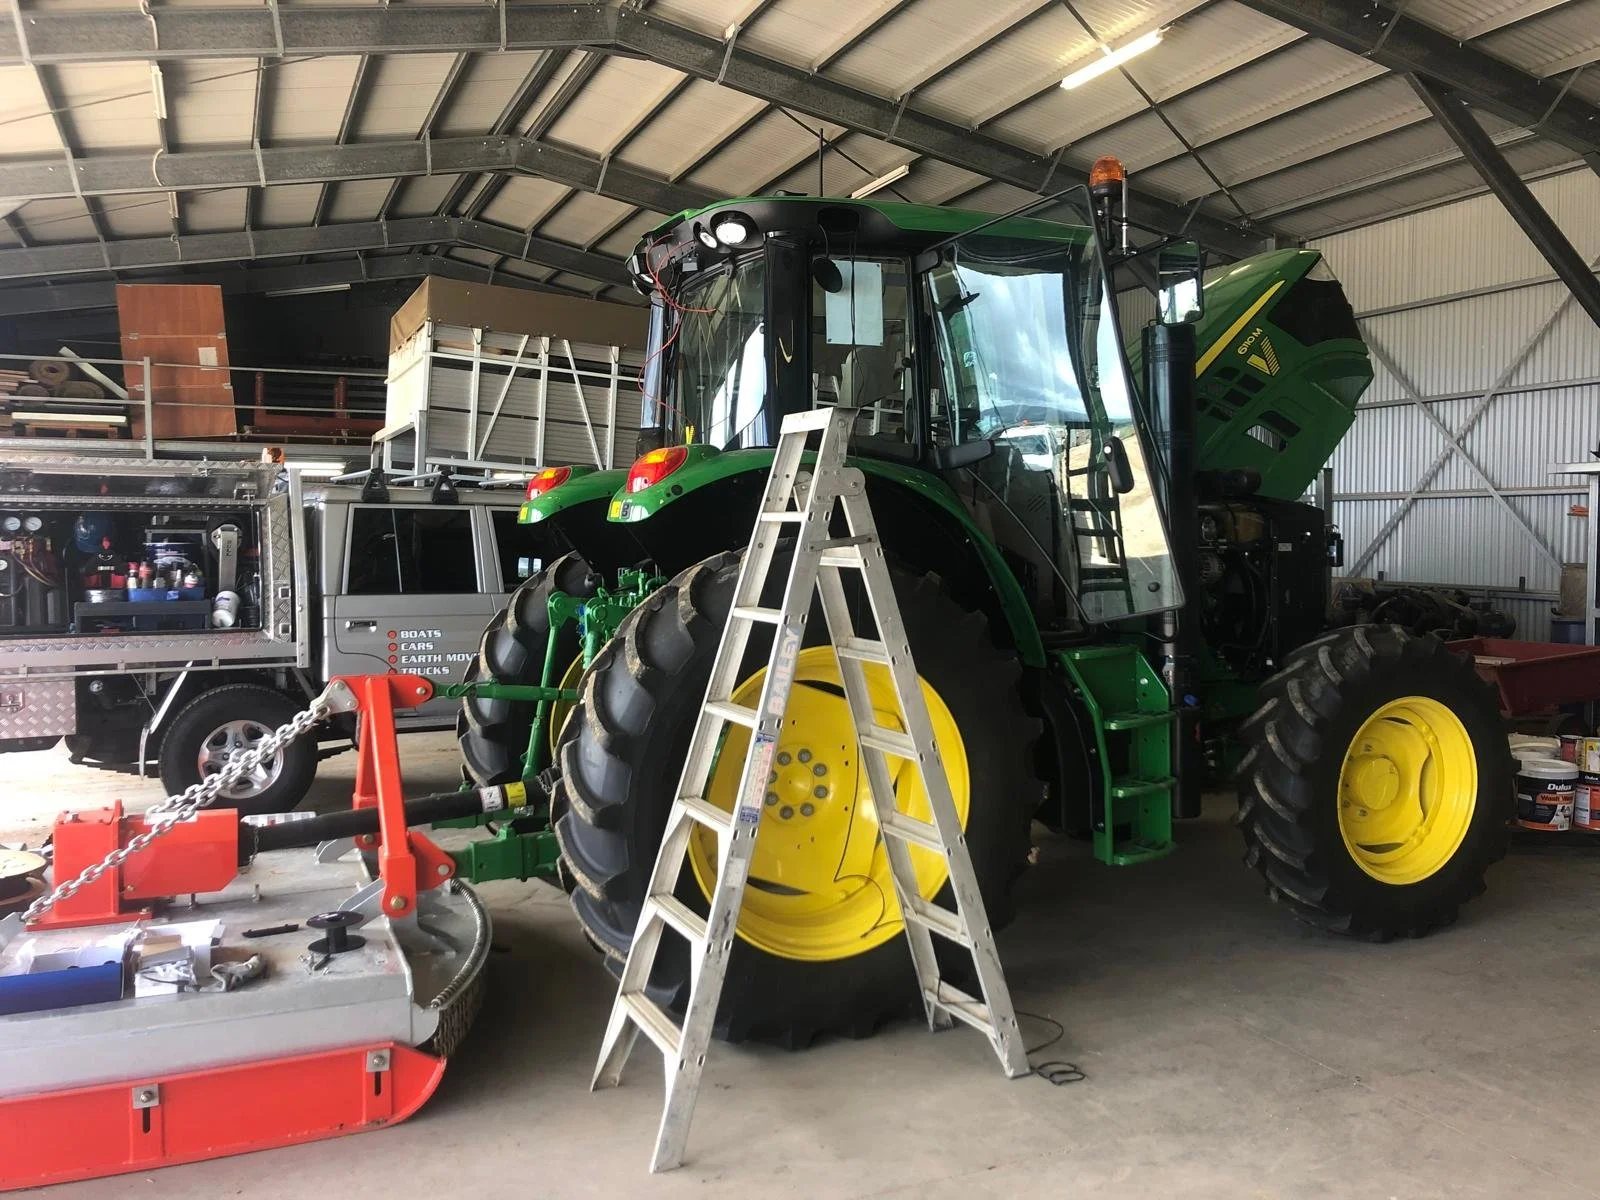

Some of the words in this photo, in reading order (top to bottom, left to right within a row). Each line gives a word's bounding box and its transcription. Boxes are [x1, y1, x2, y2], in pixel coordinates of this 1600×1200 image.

[400, 629, 442, 639] BOATS
[400, 642, 434, 651] CARS
[401, 654, 442, 664] EARTH
[446, 652, 480, 662] MOV
[400, 666, 450, 675] TRUCKS
[767, 627, 800, 717] BAILEY
[1547, 783, 1572, 791] Dulux
